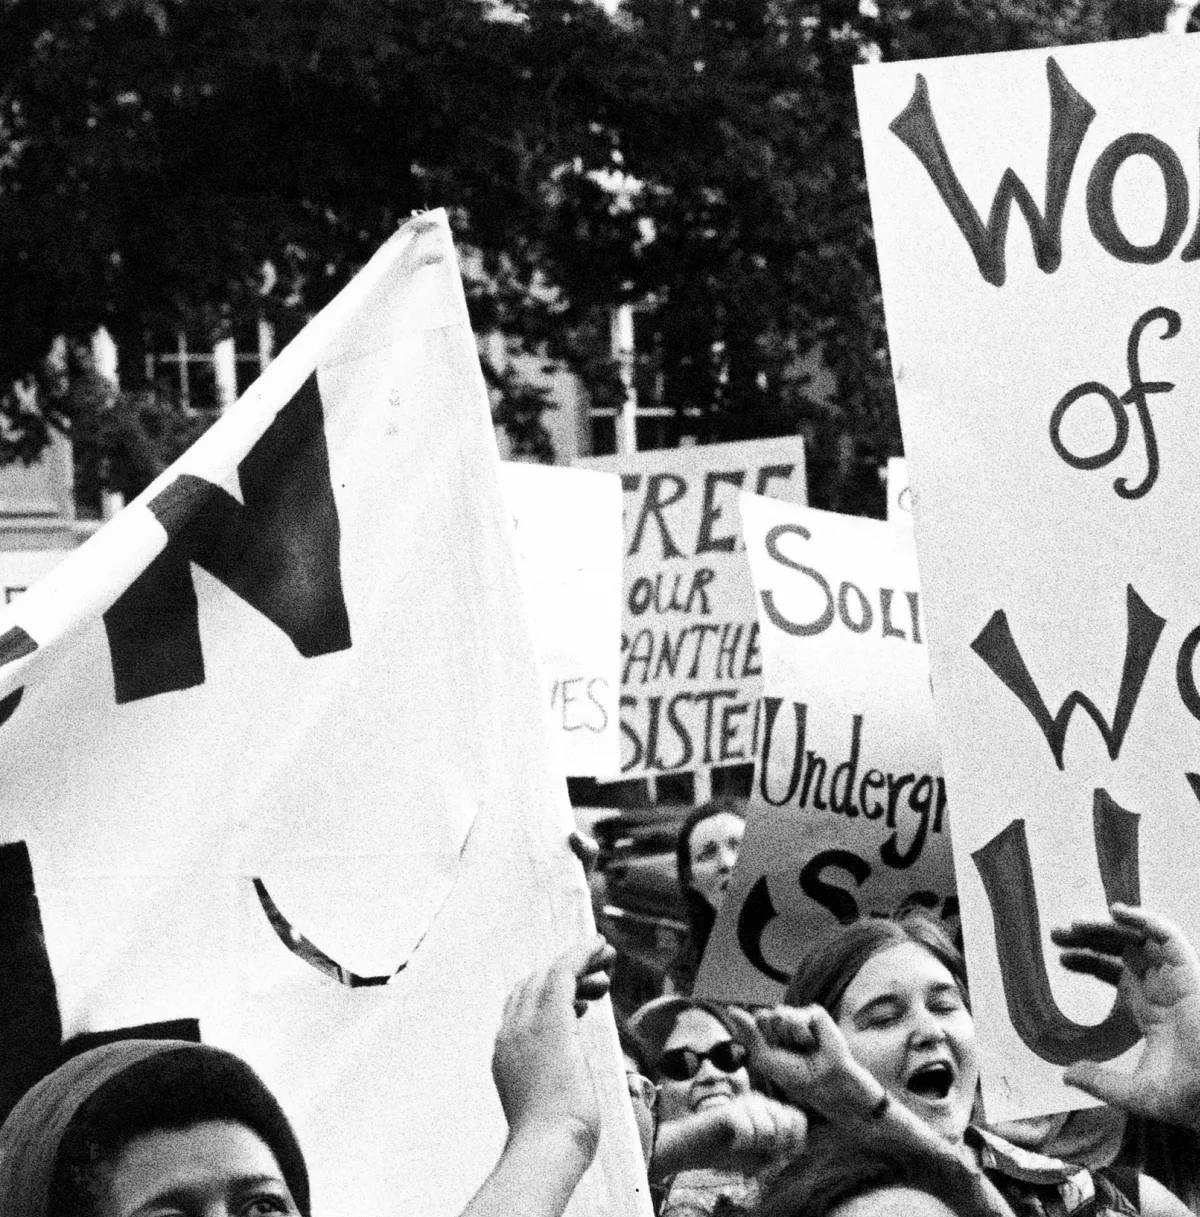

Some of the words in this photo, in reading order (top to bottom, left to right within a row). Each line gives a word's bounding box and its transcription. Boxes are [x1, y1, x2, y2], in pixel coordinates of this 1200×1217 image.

[1050, 306, 1181, 500] of
[0, 368, 353, 705] N
[621, 464, 794, 560] RE
[627, 568, 715, 616] OUR
[620, 622, 762, 685] ANTHE
[619, 690, 761, 773] SISTE
